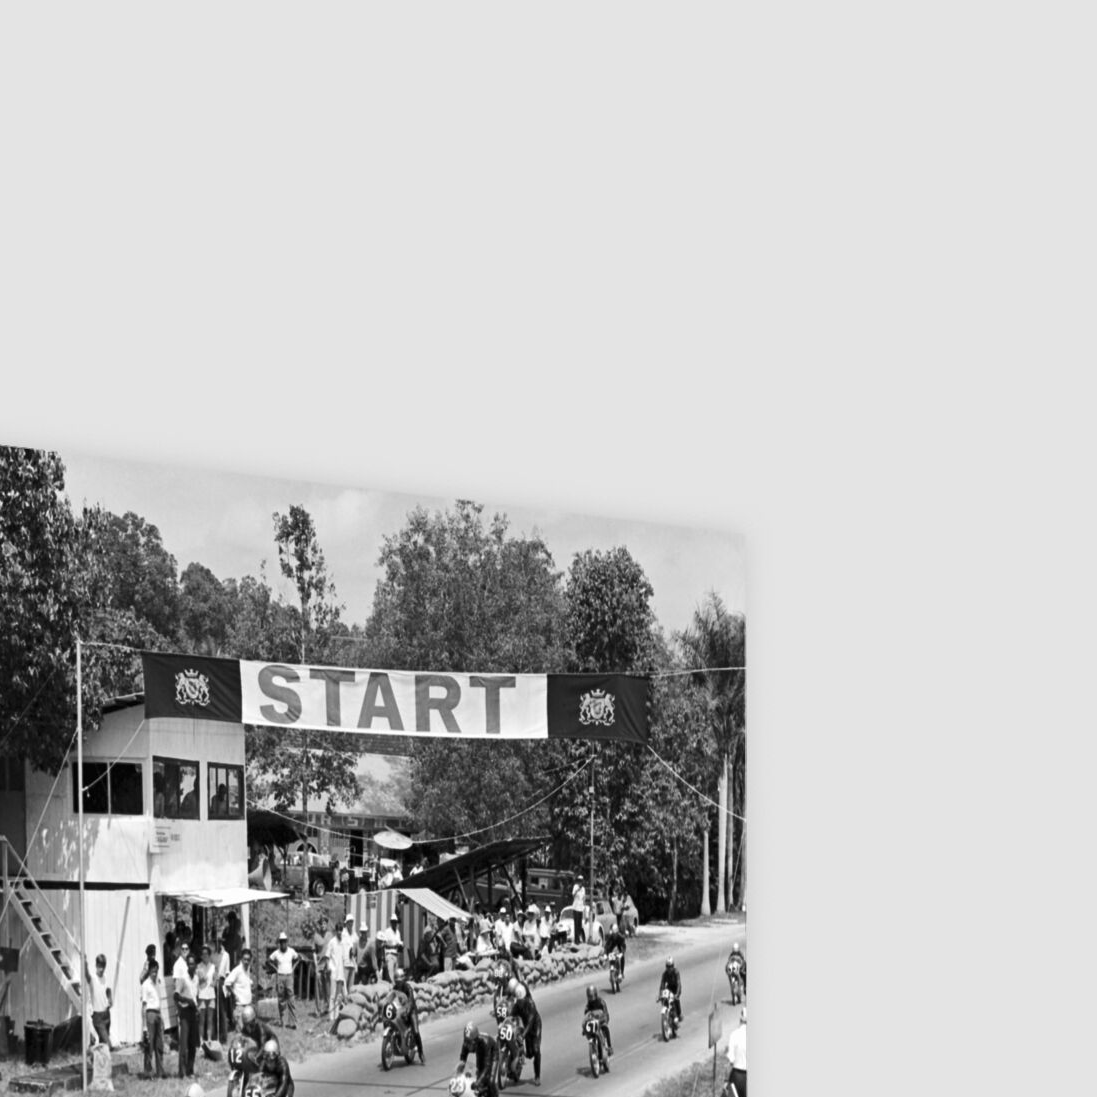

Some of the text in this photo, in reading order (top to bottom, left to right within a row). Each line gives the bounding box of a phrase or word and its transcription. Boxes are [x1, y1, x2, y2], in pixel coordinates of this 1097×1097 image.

[257, 664, 516, 734] START
[386, 1004, 393, 1018] 6
[231, 1048, 243, 1063] 12
